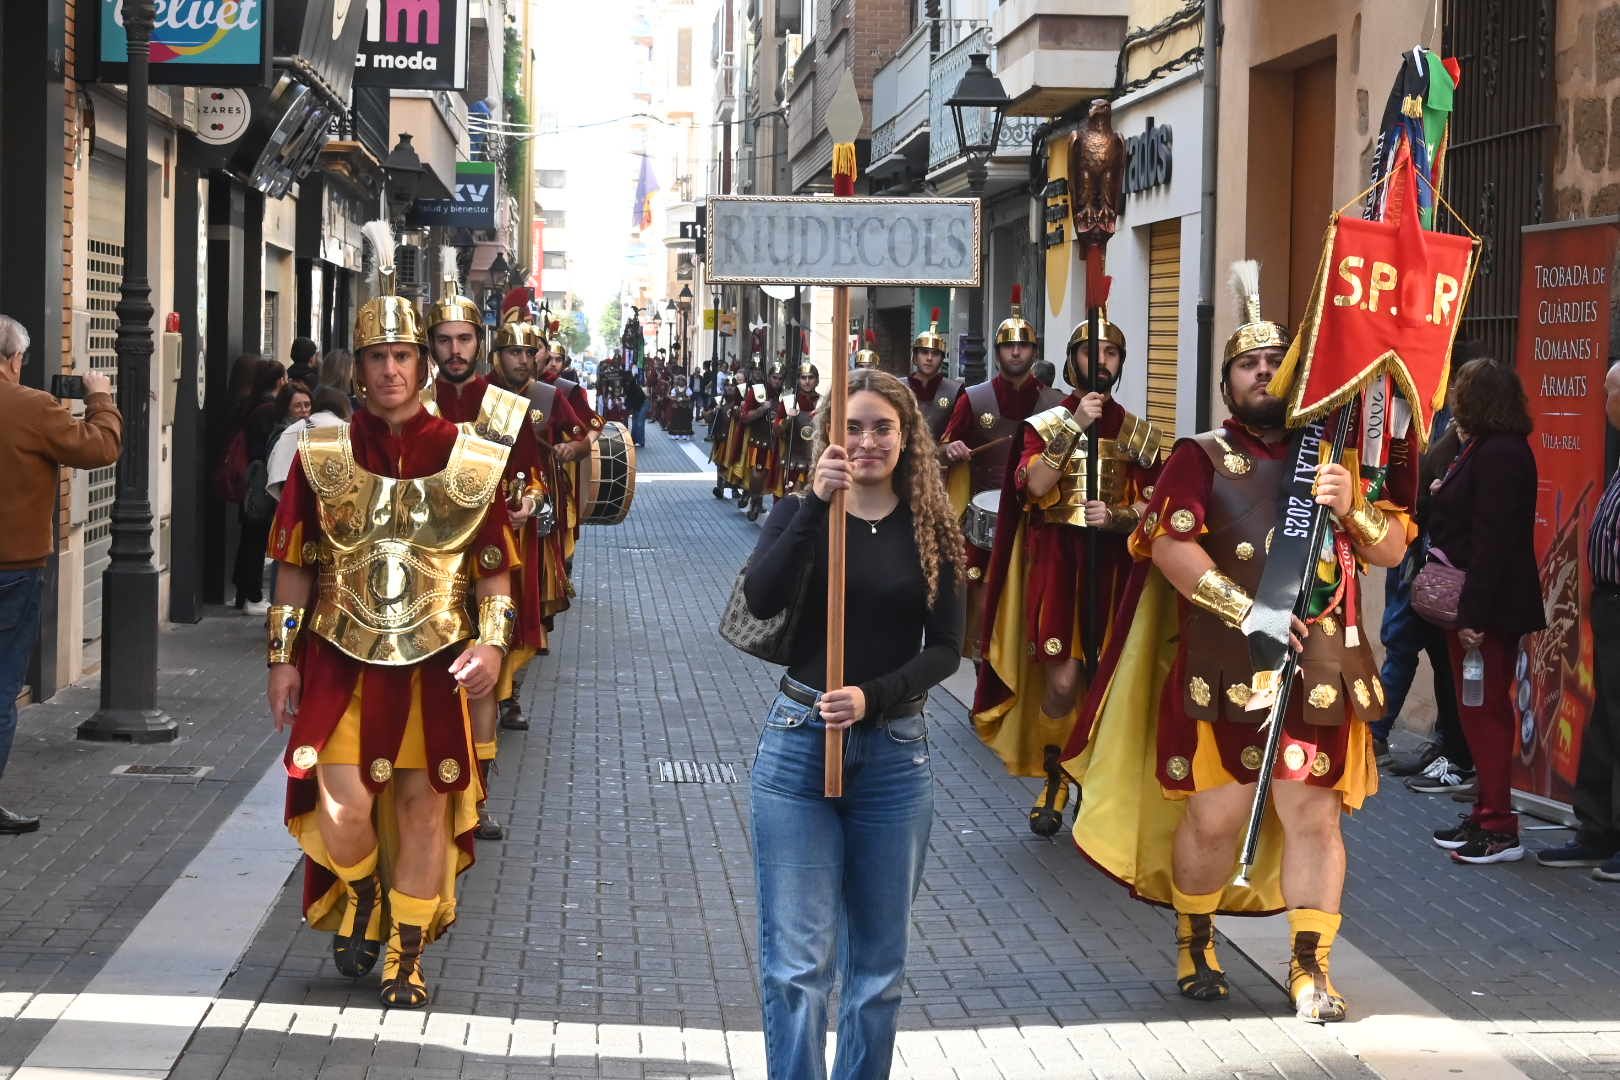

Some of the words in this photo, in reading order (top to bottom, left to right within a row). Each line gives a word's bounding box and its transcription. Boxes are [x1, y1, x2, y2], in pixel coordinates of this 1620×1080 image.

[114, 0, 258, 30] elvet
[373, 51, 437, 71] moda
[450, 205, 489, 213] bienestar
[716, 214, 966, 268] RIUDECOLS
[1535, 265, 1589, 288] TROBADA
[1535, 337, 1591, 361] ROMANES
[1540, 374, 1587, 397] ARMATS
[1284, 496, 1313, 538] 2025
